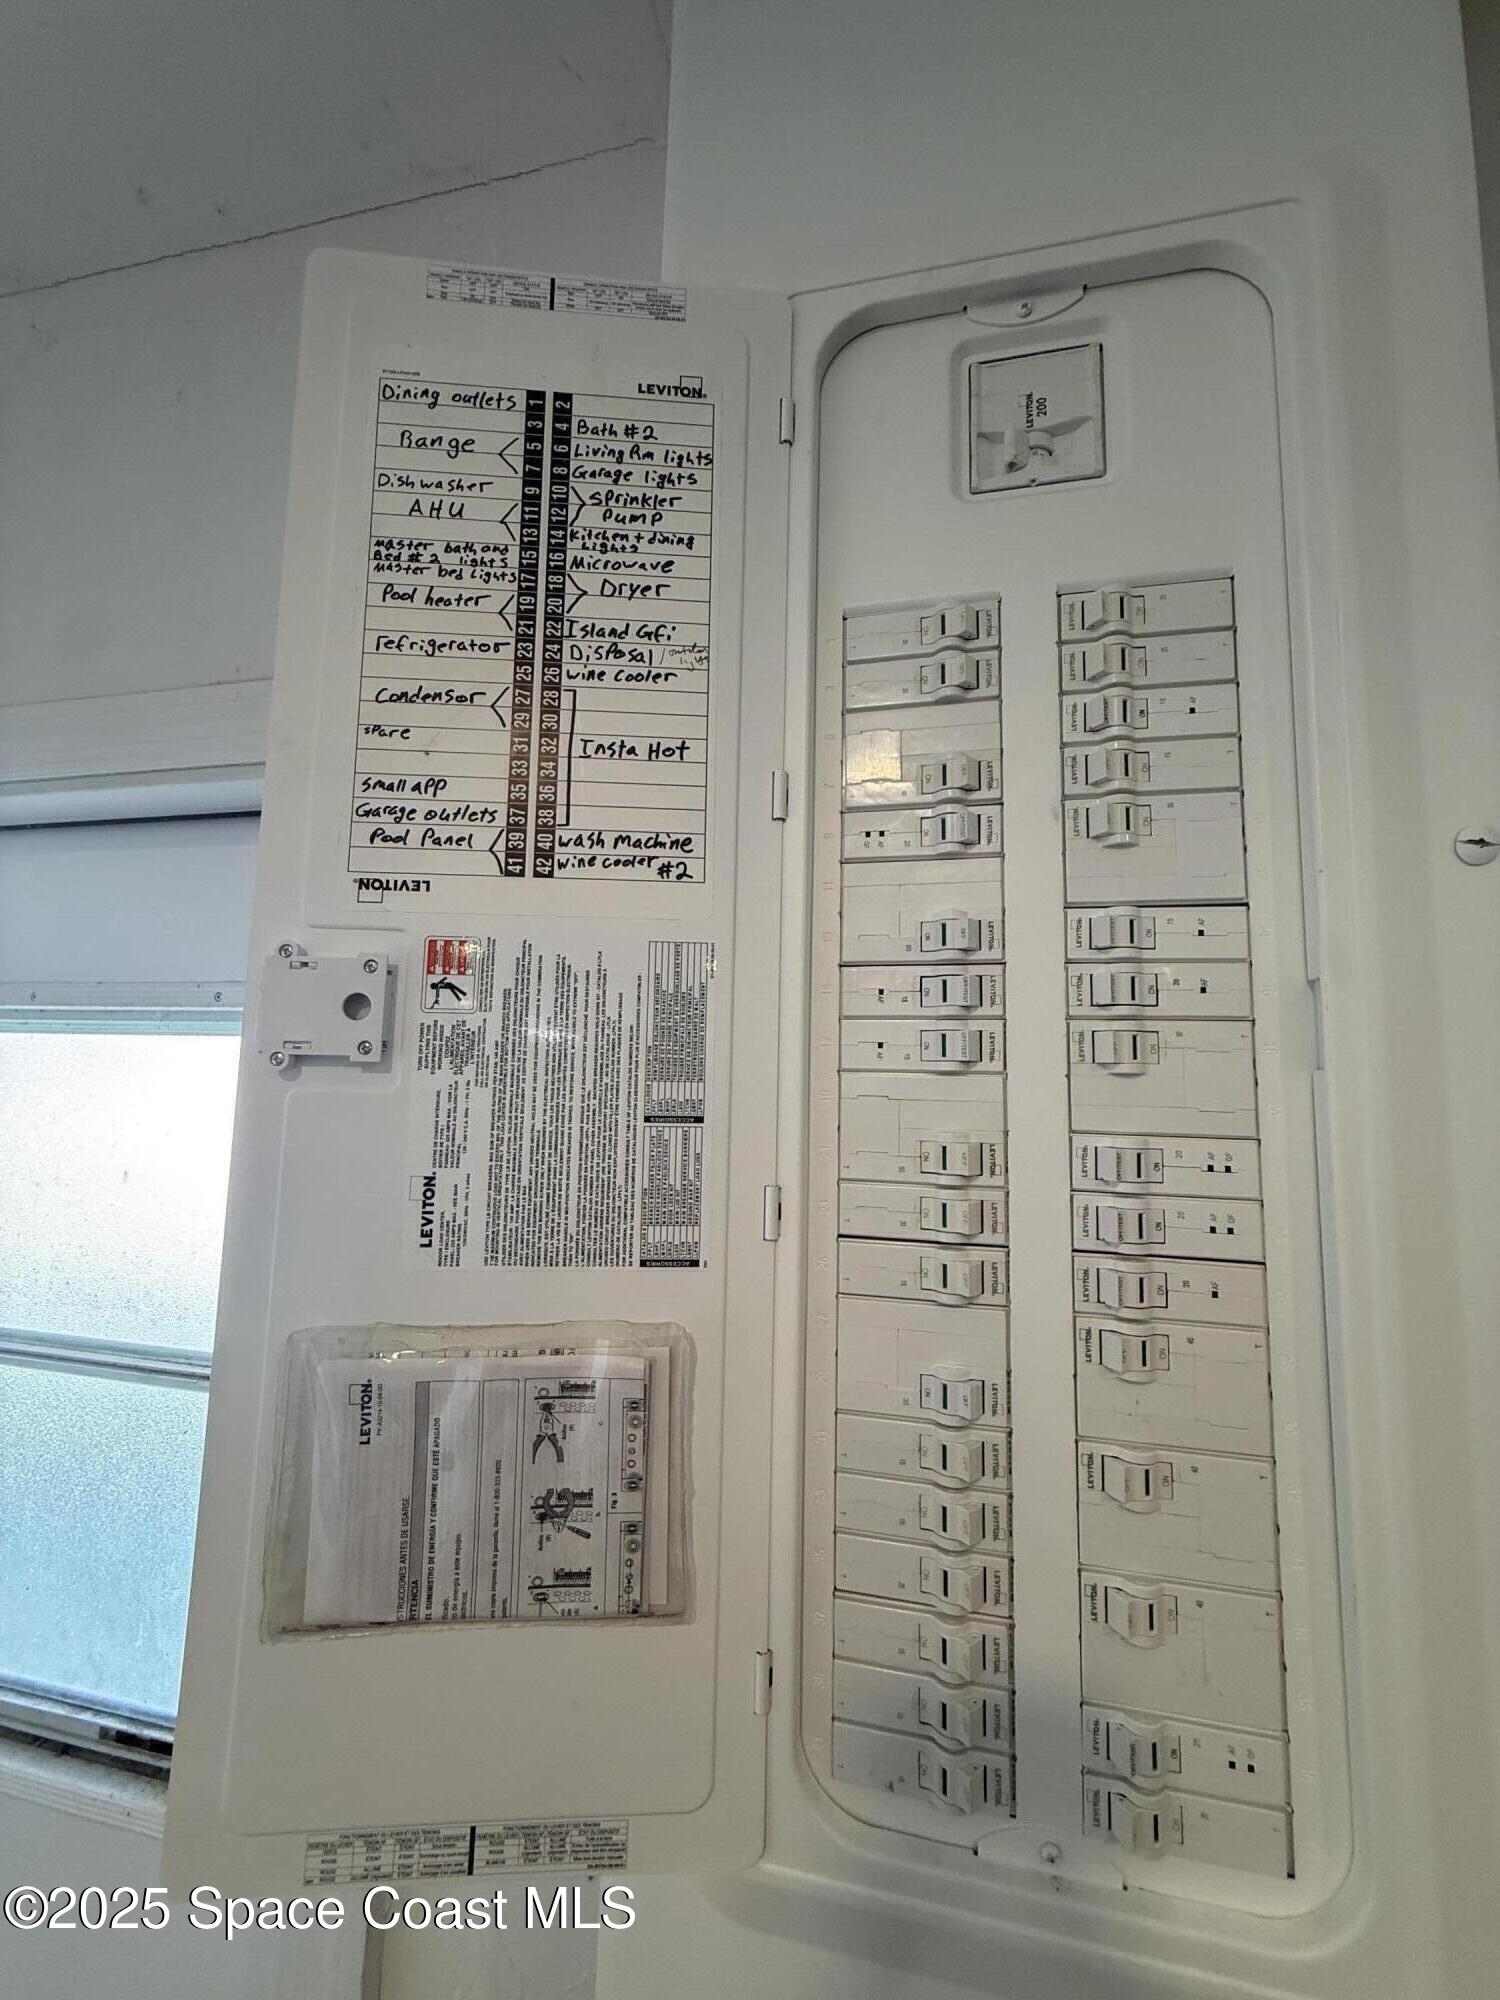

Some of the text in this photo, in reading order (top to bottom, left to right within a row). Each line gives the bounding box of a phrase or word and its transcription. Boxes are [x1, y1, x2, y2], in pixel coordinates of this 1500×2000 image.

[382, 383, 517, 411] Dining outlets
[638, 383, 702, 399] LEVITON
[556, 400, 570, 408] 2
[1036, 397, 1048, 417] 200
[577, 419, 618, 437] Bath
[400, 430, 476, 459] Range
[526, 442, 542, 450] 5
[554, 444, 568, 452] 6
[574, 443, 625, 465] Living
[664, 449, 713, 468] lights
[526, 464, 540, 472] 7
[553, 466, 568, 474] 8
[378, 473, 494, 492] Dishwasher
[572, 465, 697, 488] Garage lights
[552, 485, 567, 499] 10
[409, 499, 464, 520] AHU
[523, 507, 538, 521] 11
[551, 508, 566, 522] 12
[522, 528, 538, 542] 13
[550, 530, 564, 544] 14
[648, 531, 695, 550] dining
[444, 542, 477, 555] bath
[481, 543, 509, 556] and
[460, 555, 508, 568] lights
[522, 550, 536, 565] 15
[550, 552, 564, 567] 16
[570, 555, 675, 573] Microwave
[438, 565, 463, 580] bed
[520, 573, 536, 588] 17
[548, 575, 563, 589] 18
[600, 578, 671, 601] Dryer
[382, 583, 492, 607] Pool heater
[520, 596, 534, 611] 19
[547, 598, 562, 612] 20
[518, 619, 534, 634] 21
[546, 620, 561, 636] 22
[564, 619, 630, 640] Island
[517, 642, 532, 657] 23
[545, 644, 560, 658] 24
[516, 665, 532, 681] 25
[544, 667, 560, 682] 26
[375, 685, 487, 704] Condensor
[515, 689, 530, 704] 27
[543, 690, 559, 706] 28
[514, 712, 530, 728] 29
[542, 714, 558, 730] 30
[514, 736, 528, 752] 31
[542, 738, 556, 753] 32
[579, 739, 690, 761] Insta Hot
[512, 760, 528, 776] 33
[540, 762, 556, 776] 34
[510, 784, 526, 800] 35
[539, 785, 554, 800] 36
[355, 802, 498, 824] Garage outlets
[510, 808, 525, 824] 37
[538, 809, 554, 825] 38
[369, 828, 473, 849] Pool Panel
[508, 832, 524, 848] 39
[537, 834, 552, 849] 40
[507, 858, 523, 873] 41
[536, 858, 552, 874] 42
[358, 878, 431, 892] LEVITON
[419, 1176, 436, 1248] LEVITON
[359, 1384, 372, 1445] LEVITON
[402, 1529, 409, 1538] DE
[400, 1541, 409, 1564] ANTES
[426, 1566, 435, 1610] SUMINISTRO
